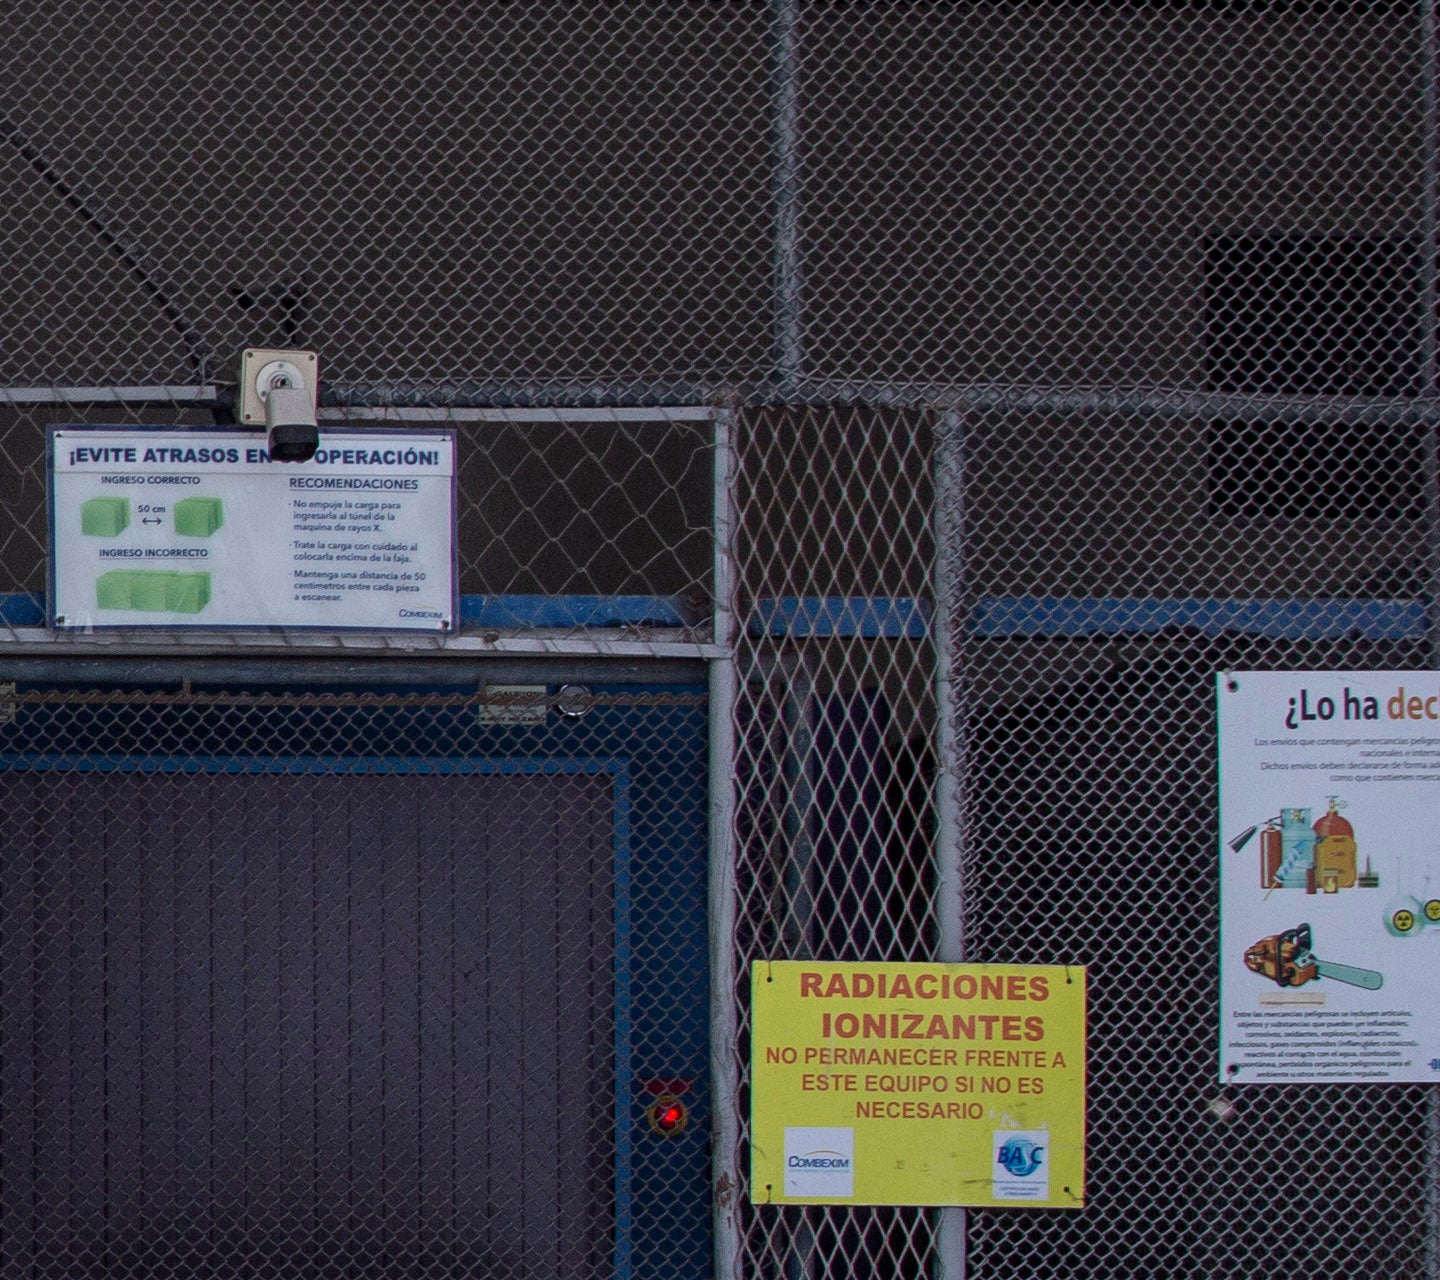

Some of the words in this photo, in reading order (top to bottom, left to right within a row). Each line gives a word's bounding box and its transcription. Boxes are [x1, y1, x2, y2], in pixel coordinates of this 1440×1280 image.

[70, 447, 136, 466] ¡EVITE
[143, 447, 239, 463] ATRASOS
[246, 448, 272, 463] EN
[314, 446, 439, 465] OPERACIÓN!
[101, 475, 145, 485] INGRESO
[147, 476, 200, 485] CORRECTO
[289, 477, 418, 490] RECOMENDACIONES
[137, 505, 150, 513] 50
[293, 500, 307, 508] No
[308, 501, 343, 511] empuje
[344, 500, 353, 509] la
[354, 502, 380, 511] carga
[381, 502, 401, 511] para
[339, 512, 347, 520] al
[373, 513, 385, 521] de
[387, 513, 395, 521] la
[347, 525, 372, 534] rayos
[293, 541, 315, 549] Trate
[317, 541, 326, 549] la
[327, 543, 352, 551] carga
[372, 542, 408, 551] cuidado
[410, 543, 418, 551] al
[99, 548, 142, 558] INGRESO
[145, 549, 208, 558] INCORRECTO
[293, 553, 334, 561] colocarla
[336, 553, 368, 562] encima
[370, 554, 381, 562] de
[383, 554, 391, 562] la
[294, 570, 339, 580] Mantenga
[359, 571, 399, 580] distancia
[400, 572, 412, 580] de
[414, 573, 426, 581] 50
[347, 583, 371, 591] entre
[372, 583, 394, 591] cada
[396, 584, 420, 593] pieza
[1285, 688, 1335, 730] ¿Lo
[1344, 687, 1379, 721] ha
[1387, 686, 1440, 721] dec
[800, 972, 1050, 1001] RADIACIONES
[822, 1012, 1045, 1041] IONIZANTES
[766, 1047, 797, 1064] NO
[804, 1048, 957, 1066] PERMANECER
[966, 1050, 1047, 1068] FRENTE
[1052, 1051, 1066, 1068] A
[802, 1074, 858, 1091] ESTE
[865, 1075, 948, 1093] EQUIPO
[955, 1076, 974, 1093] SI
[981, 1077, 1011, 1094] NO
[1018, 1077, 1044, 1094] ES
[856, 1101, 983, 1120] NECESARIO
[788, 1155, 849, 1168] COMBEXIM
